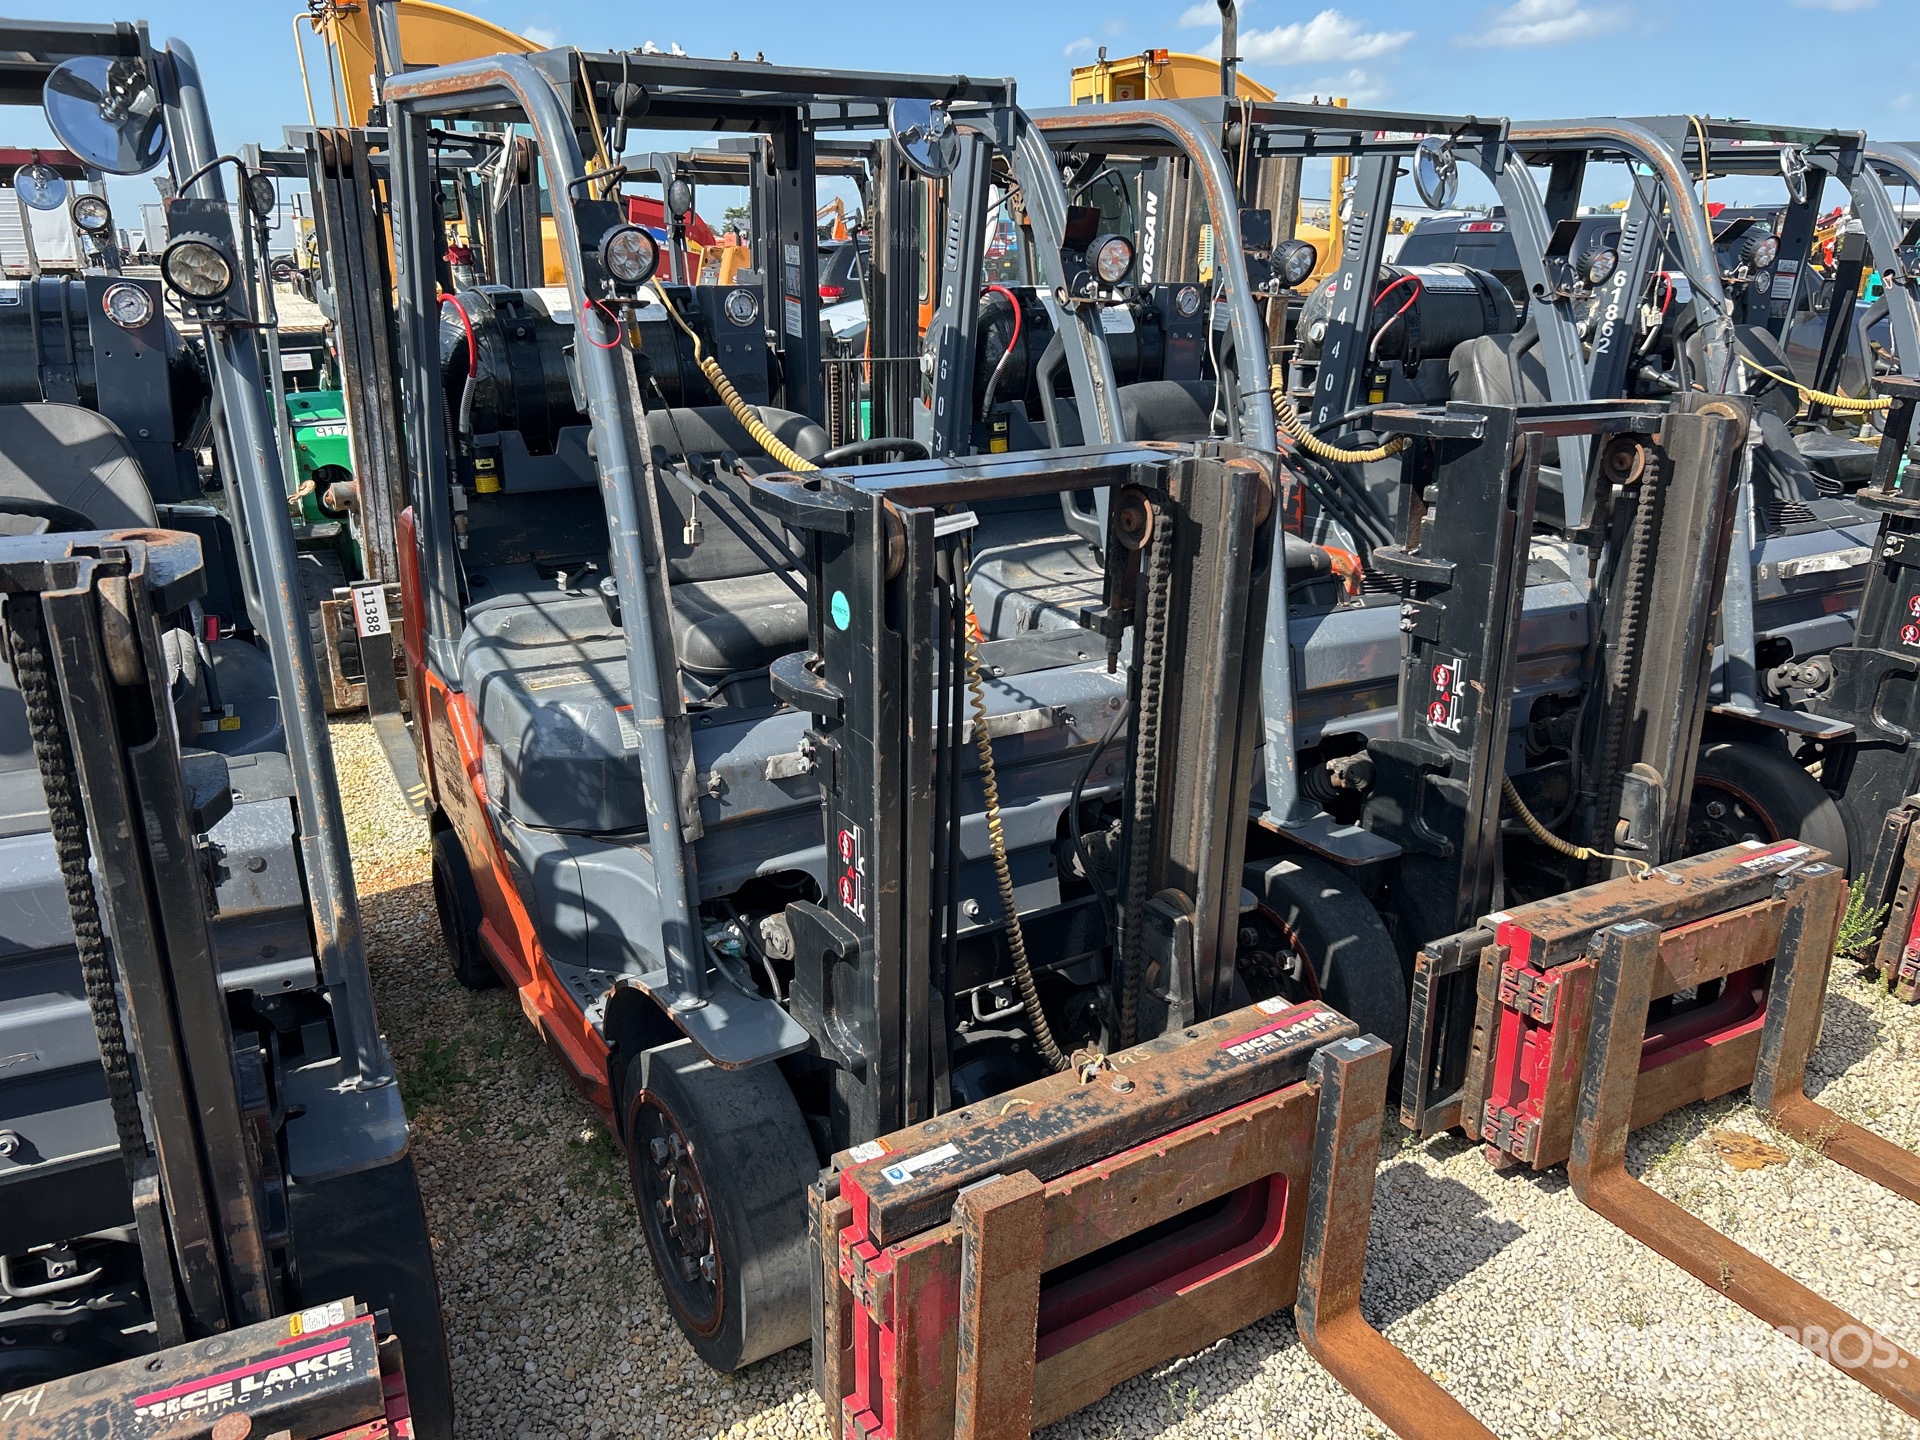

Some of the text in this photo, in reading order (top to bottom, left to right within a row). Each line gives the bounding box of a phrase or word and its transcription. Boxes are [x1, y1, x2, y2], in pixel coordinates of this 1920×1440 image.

[1141, 190, 1158, 286] OOSAN
[1596, 270, 1627, 354] 61862
[1318, 272, 1353, 424] 64406
[361, 590, 381, 633] 11388
[1226, 1033, 1280, 1057] RICE
[1275, 1013, 1337, 1038] LAK
[240, 1347, 353, 1393] LAKE
[0, 1384, 46, 1422] 74
